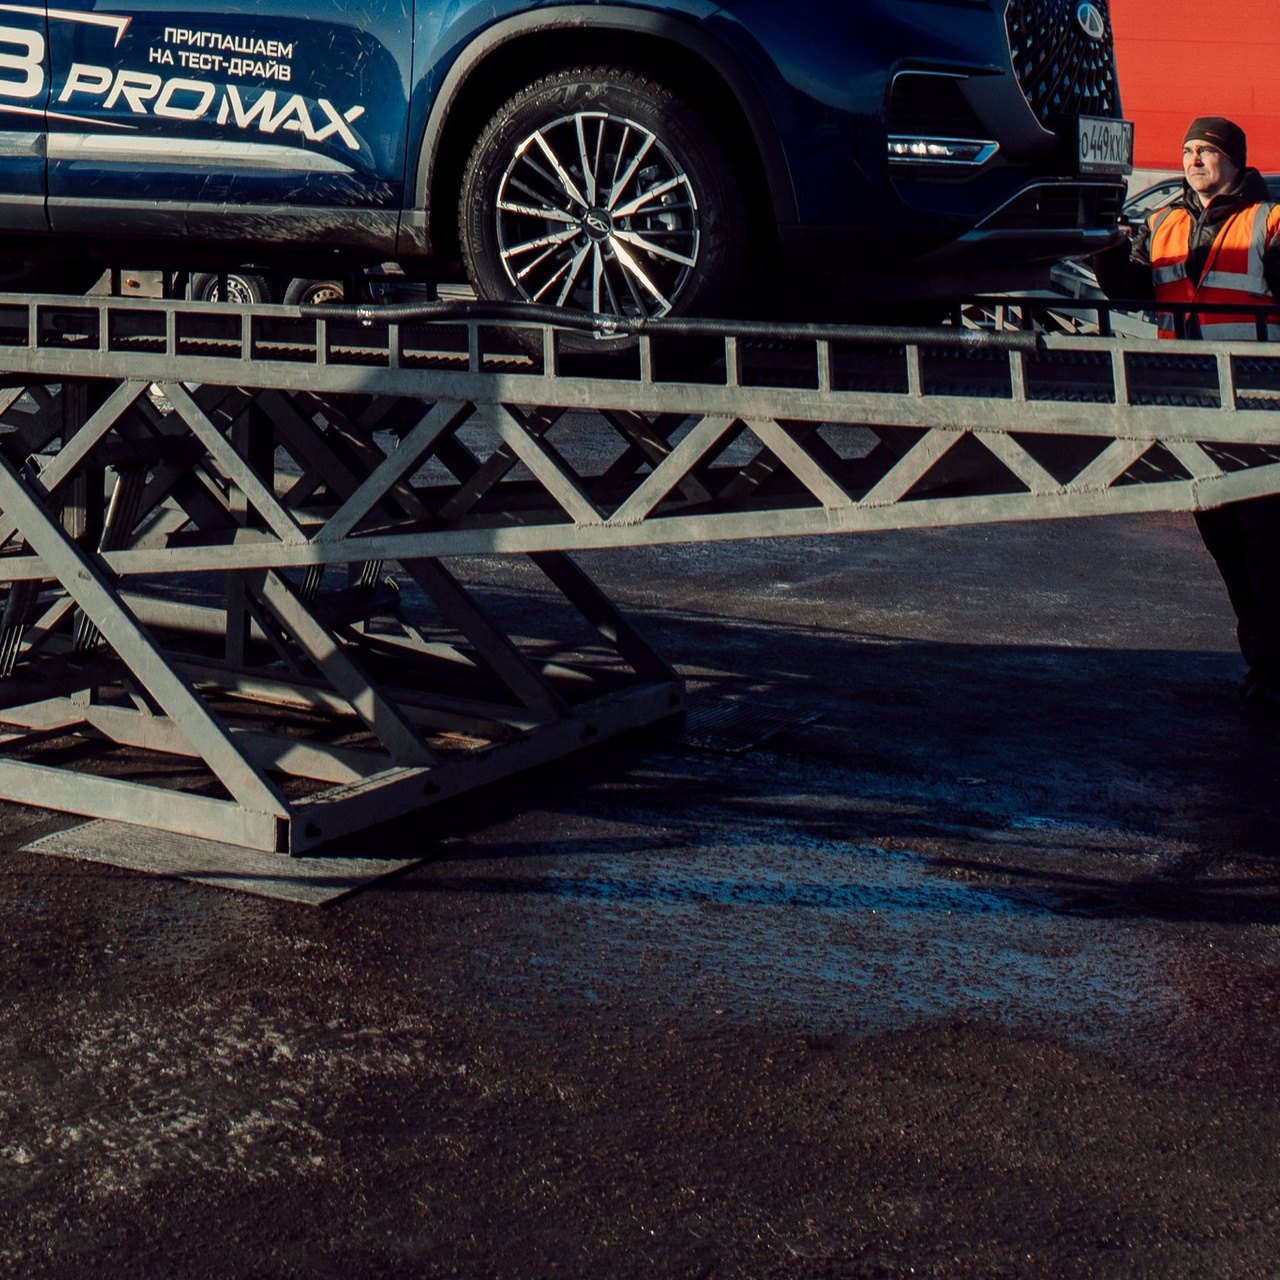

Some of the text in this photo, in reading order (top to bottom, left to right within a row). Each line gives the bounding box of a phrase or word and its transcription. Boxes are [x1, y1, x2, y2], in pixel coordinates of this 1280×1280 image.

[164, 27, 293, 59] ПРИГЛАШАЕМ
[149, 47, 291, 81] НА ТЕСТ-ДРАЙВ
